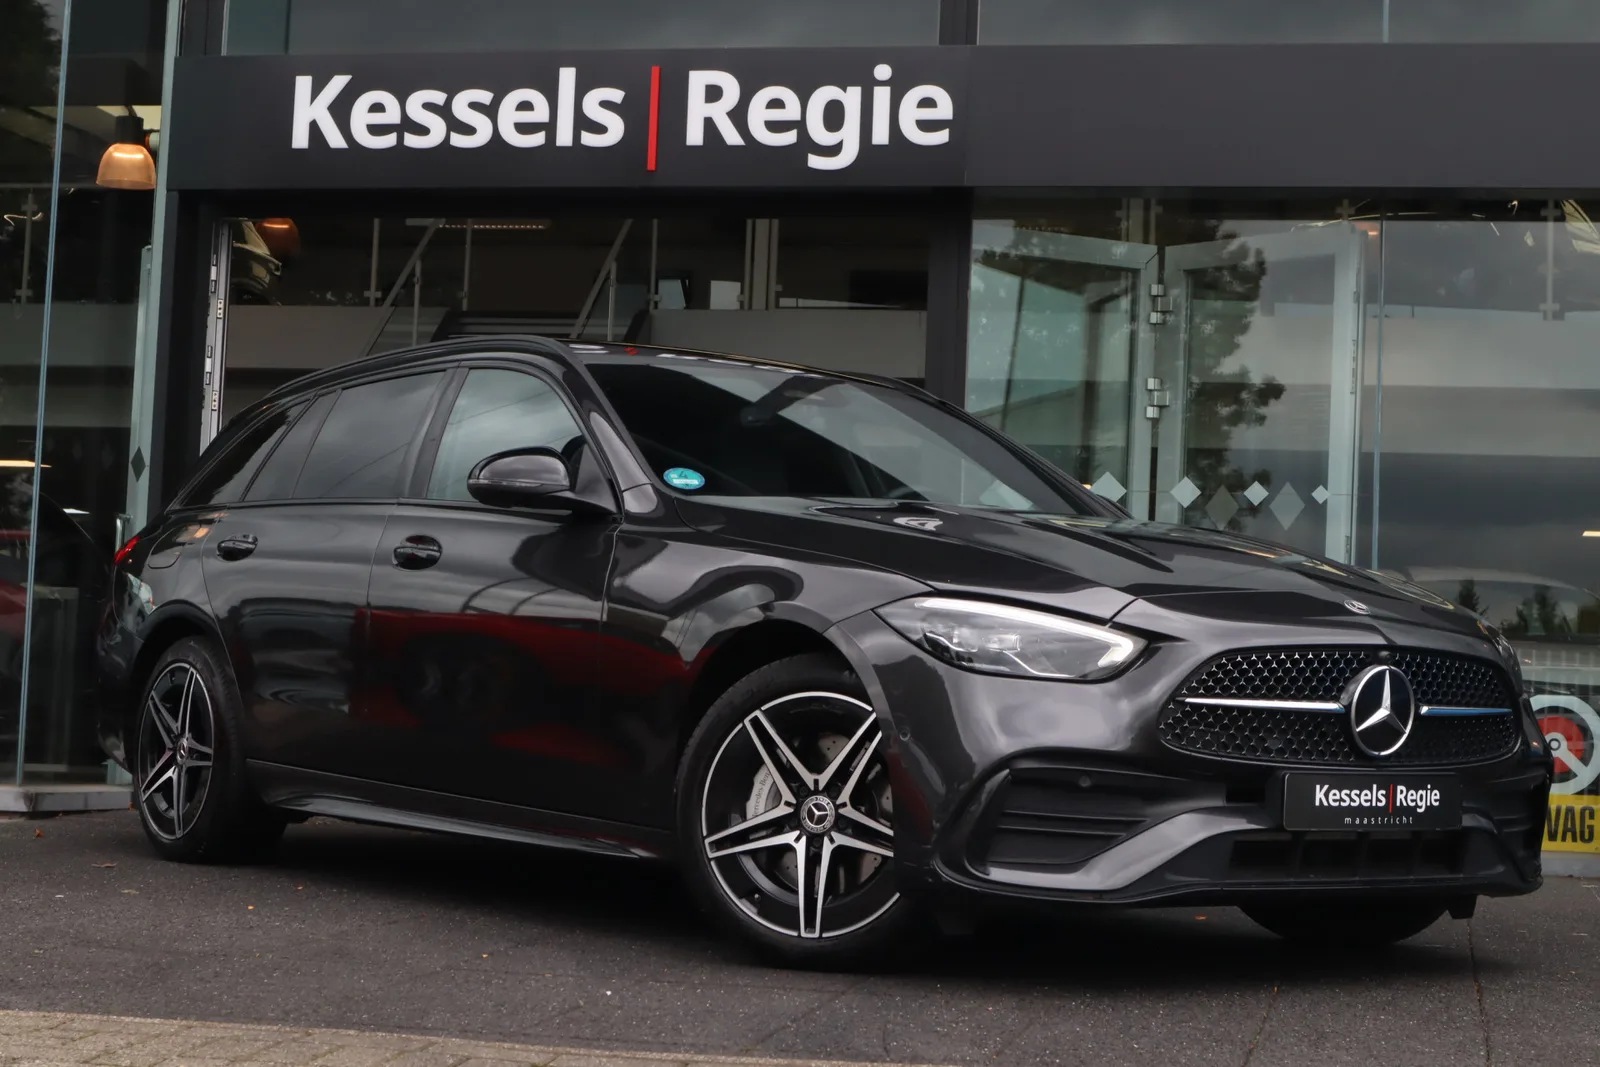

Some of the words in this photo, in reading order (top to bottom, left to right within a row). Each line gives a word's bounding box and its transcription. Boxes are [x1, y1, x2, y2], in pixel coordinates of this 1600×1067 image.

[291, 66, 626, 149] Kessels
[685, 63, 954, 171] Regie
[1314, 783, 1387, 807] Kessels
[1396, 783, 1441, 813] Regie
[1344, 815, 1413, 825] maastricht
